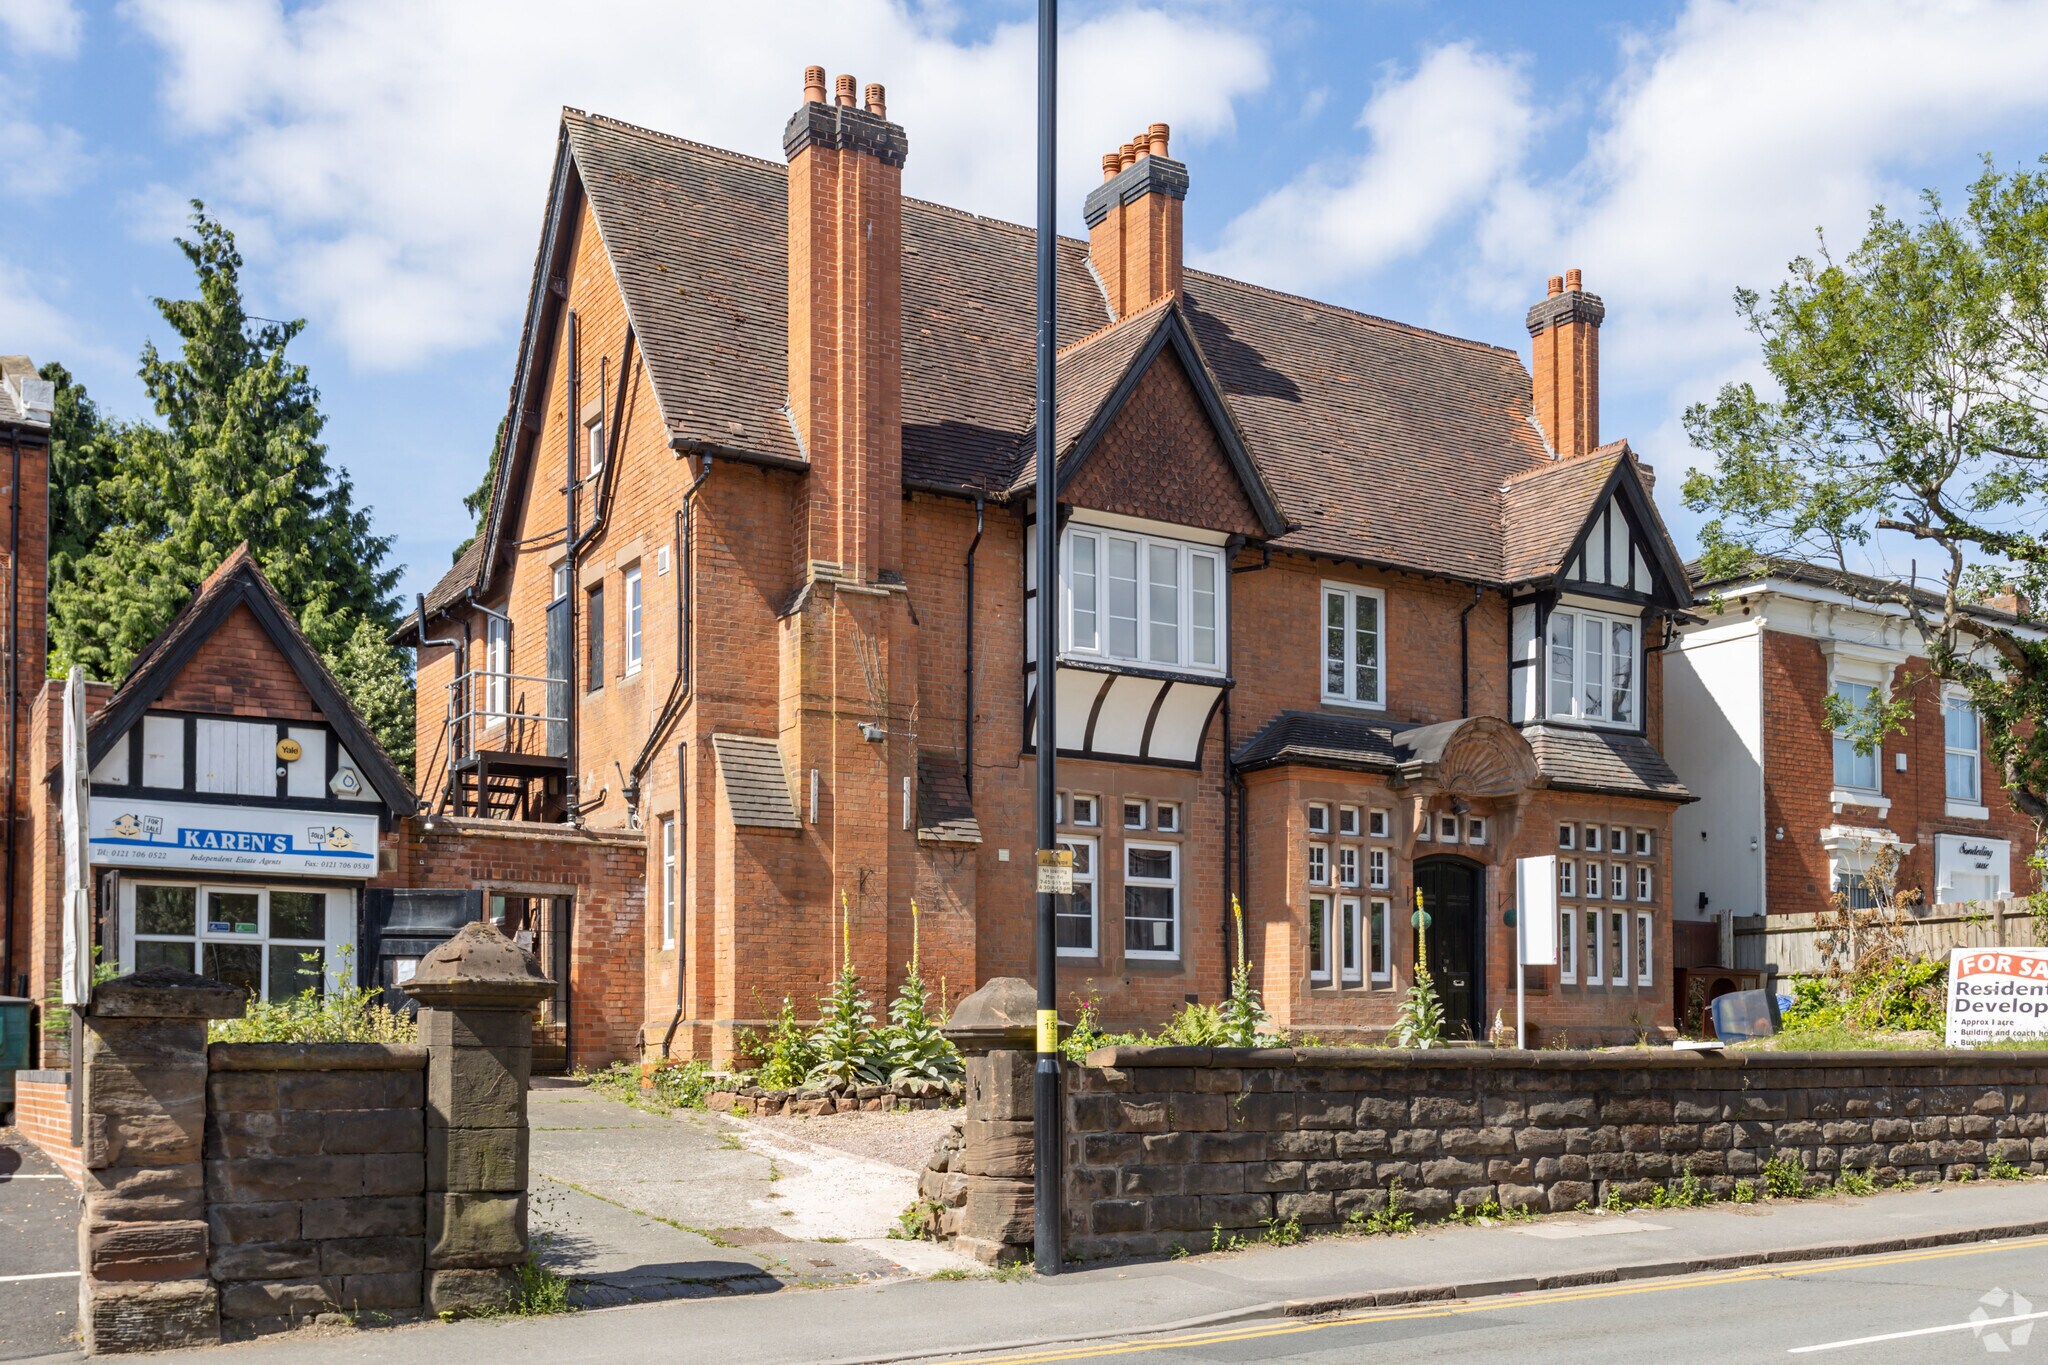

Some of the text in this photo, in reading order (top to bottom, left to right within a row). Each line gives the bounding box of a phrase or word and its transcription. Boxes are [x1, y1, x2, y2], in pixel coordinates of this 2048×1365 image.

[282, 746, 298, 754] Yale
[184, 830, 286, 852] KAREN'S
[311, 831, 324, 841] SOLD
[111, 849, 129, 858] 0121
[132, 850, 146, 859] 706
[148, 852, 167, 860] 0522
[190, 853, 282, 866] Independent Estate Agents
[304, 860, 370, 871] Fax: 0121 706 0530
[1962, 955, 2012, 975] FOR
[1955, 998, 2048, 1018] Develop
[1961, 1029, 1993, 1037] Building
